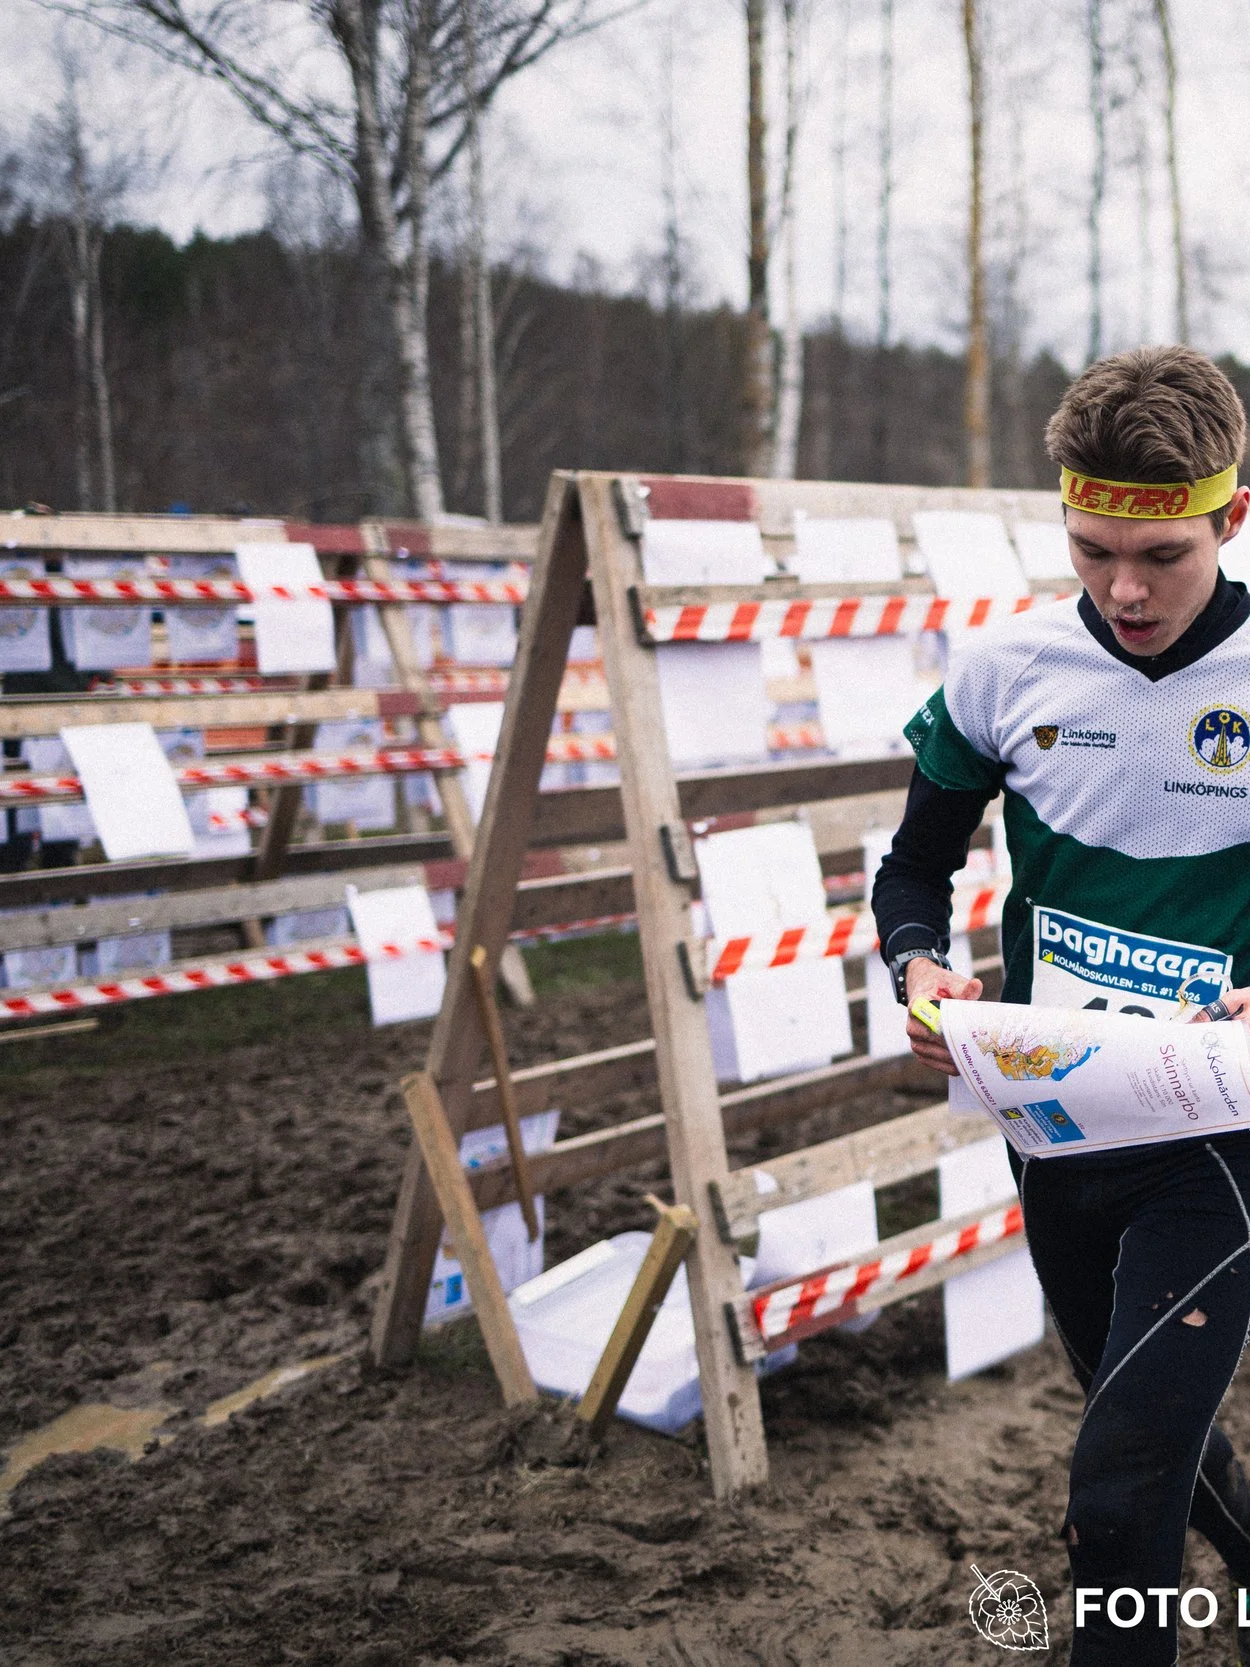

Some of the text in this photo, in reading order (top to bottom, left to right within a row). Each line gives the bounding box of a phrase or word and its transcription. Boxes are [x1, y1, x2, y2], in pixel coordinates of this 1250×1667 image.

[1068, 493, 1187, 515] SPORT
[1069, 476, 1189, 515] LETRO
[1062, 728, 1117, 743] Linköping
[1164, 780, 1248, 798] LINKÖPINGS
[1041, 914, 1226, 986] bagheera
[1054, 954, 1133, 989] KOLMÅRDSKAVLEN
[1141, 982, 1158, 995] STL
[1160, 987, 1173, 997] #1
[1160, 1044, 1199, 1121] Skinnarbo
[1207, 1055, 1239, 1117] Kolmården
